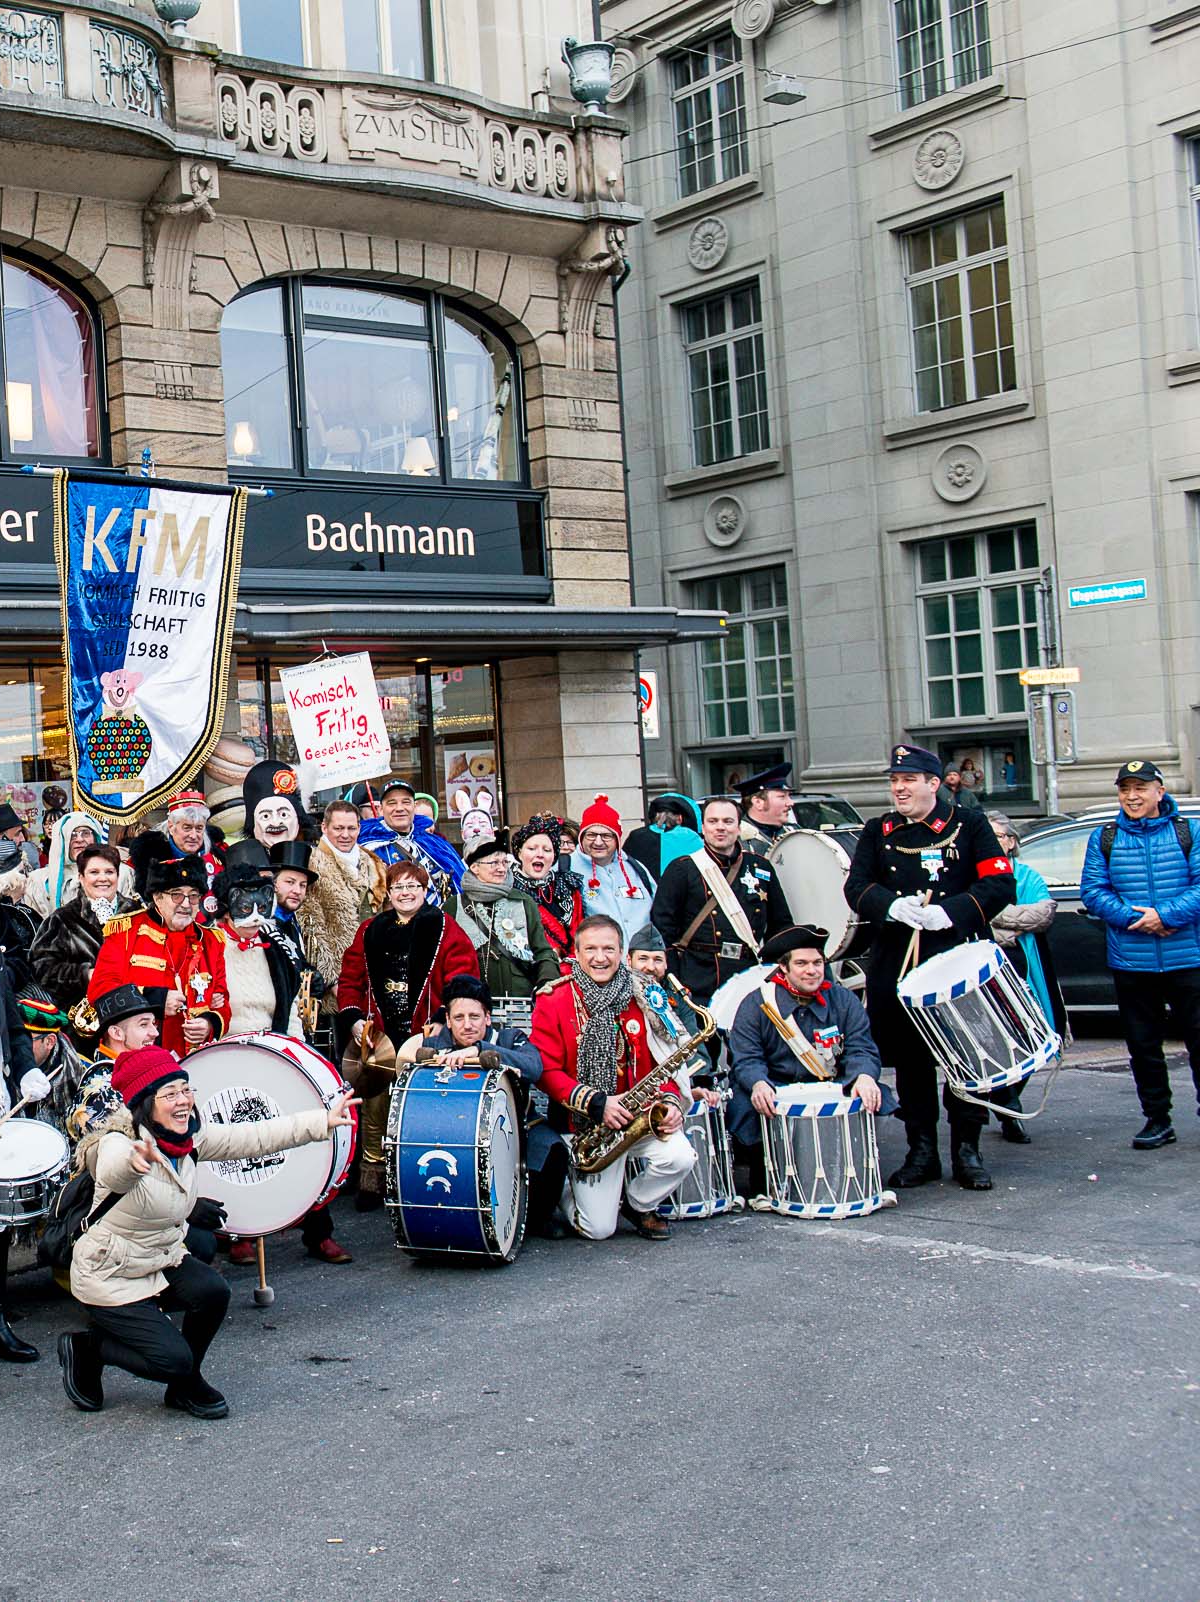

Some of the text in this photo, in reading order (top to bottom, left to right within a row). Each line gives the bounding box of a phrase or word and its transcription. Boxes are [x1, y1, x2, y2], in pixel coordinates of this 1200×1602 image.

[410, 113, 476, 150] STEIN
[82, 505, 211, 581] KFM
[306, 511, 475, 556] Bachmann
[149, 587, 206, 607] FRIITIG
[128, 642, 169, 660] 1988
[289, 675, 357, 710] Komisch
[315, 706, 368, 737] Fritig
[304, 732, 380, 761] Gesellschaft
